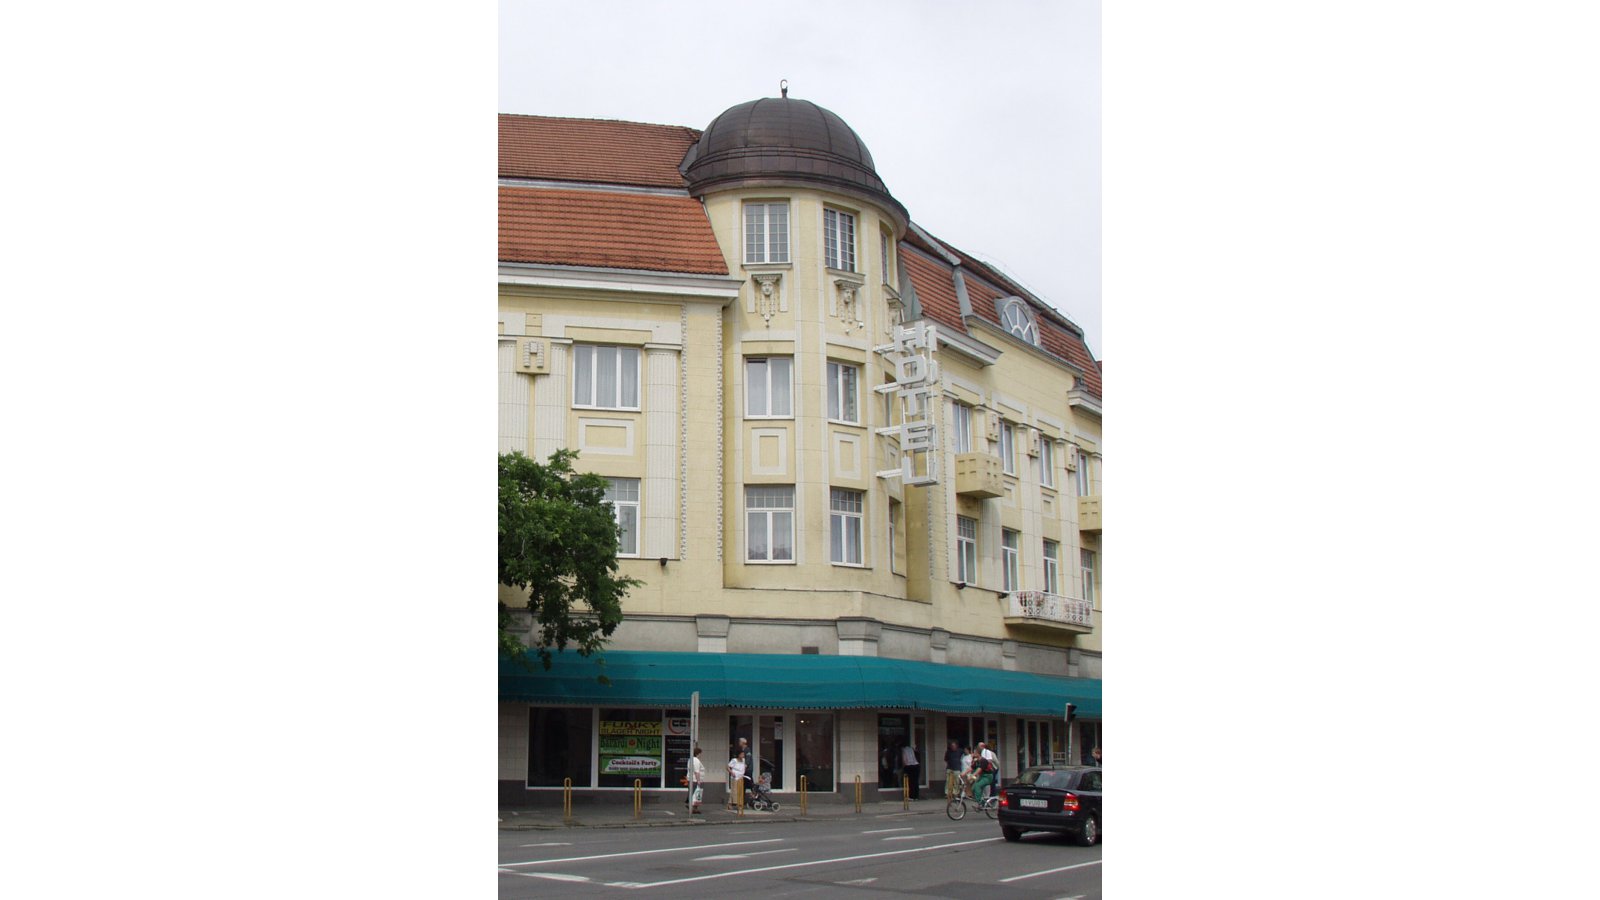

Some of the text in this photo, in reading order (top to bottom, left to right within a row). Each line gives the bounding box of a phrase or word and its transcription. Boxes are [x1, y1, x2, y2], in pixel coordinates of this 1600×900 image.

[894, 321, 937, 485] HOTEL
[602, 721, 659, 729] FUNKY
[636, 737, 660, 750] Night
